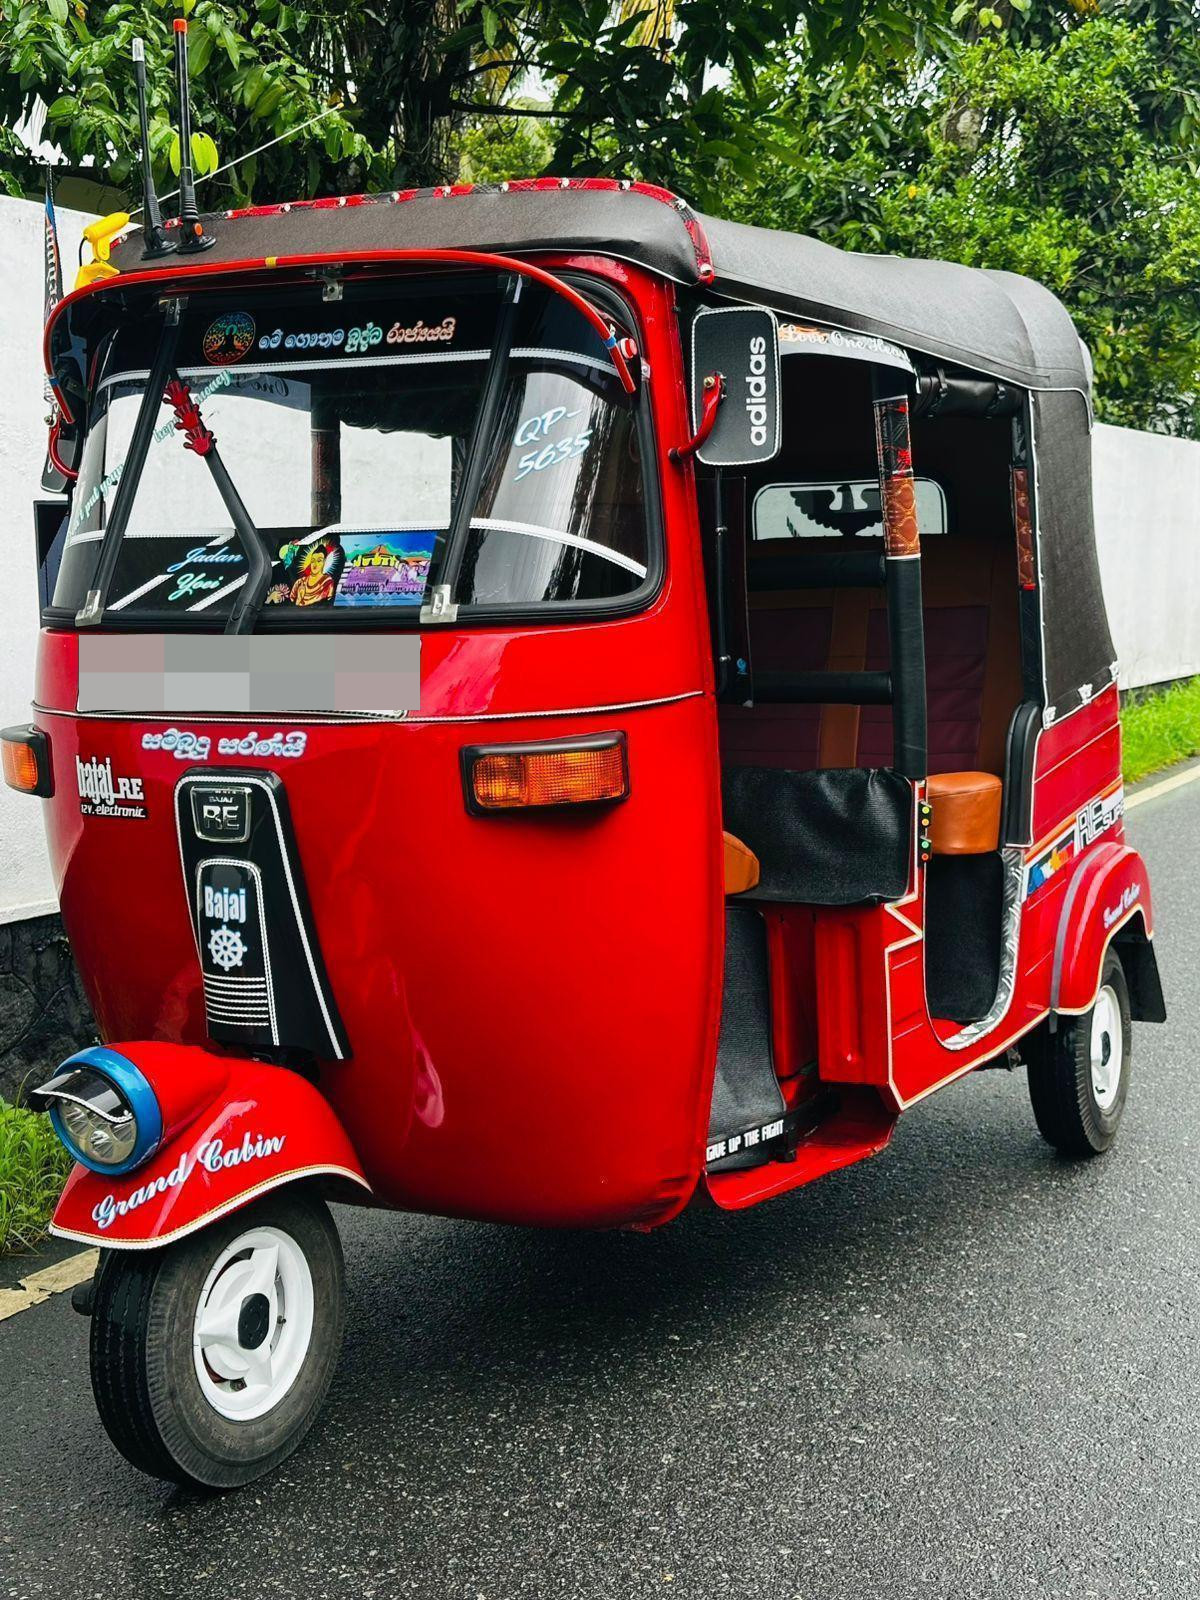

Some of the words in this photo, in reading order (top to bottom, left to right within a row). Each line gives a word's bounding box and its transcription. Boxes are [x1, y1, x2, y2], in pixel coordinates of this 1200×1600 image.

[745, 336, 767, 447] adidas
[514, 428, 594, 482] 5635
[203, 804, 241, 831] RE
[204, 885, 247, 924] Bajaj
[727, 1135, 742, 1154] UP
[743, 1128, 761, 1148] THE
[761, 1119, 785, 1142] FIGHT
[91, 1151, 194, 1230] Grand
[196, 1131, 287, 1173] Cabin
